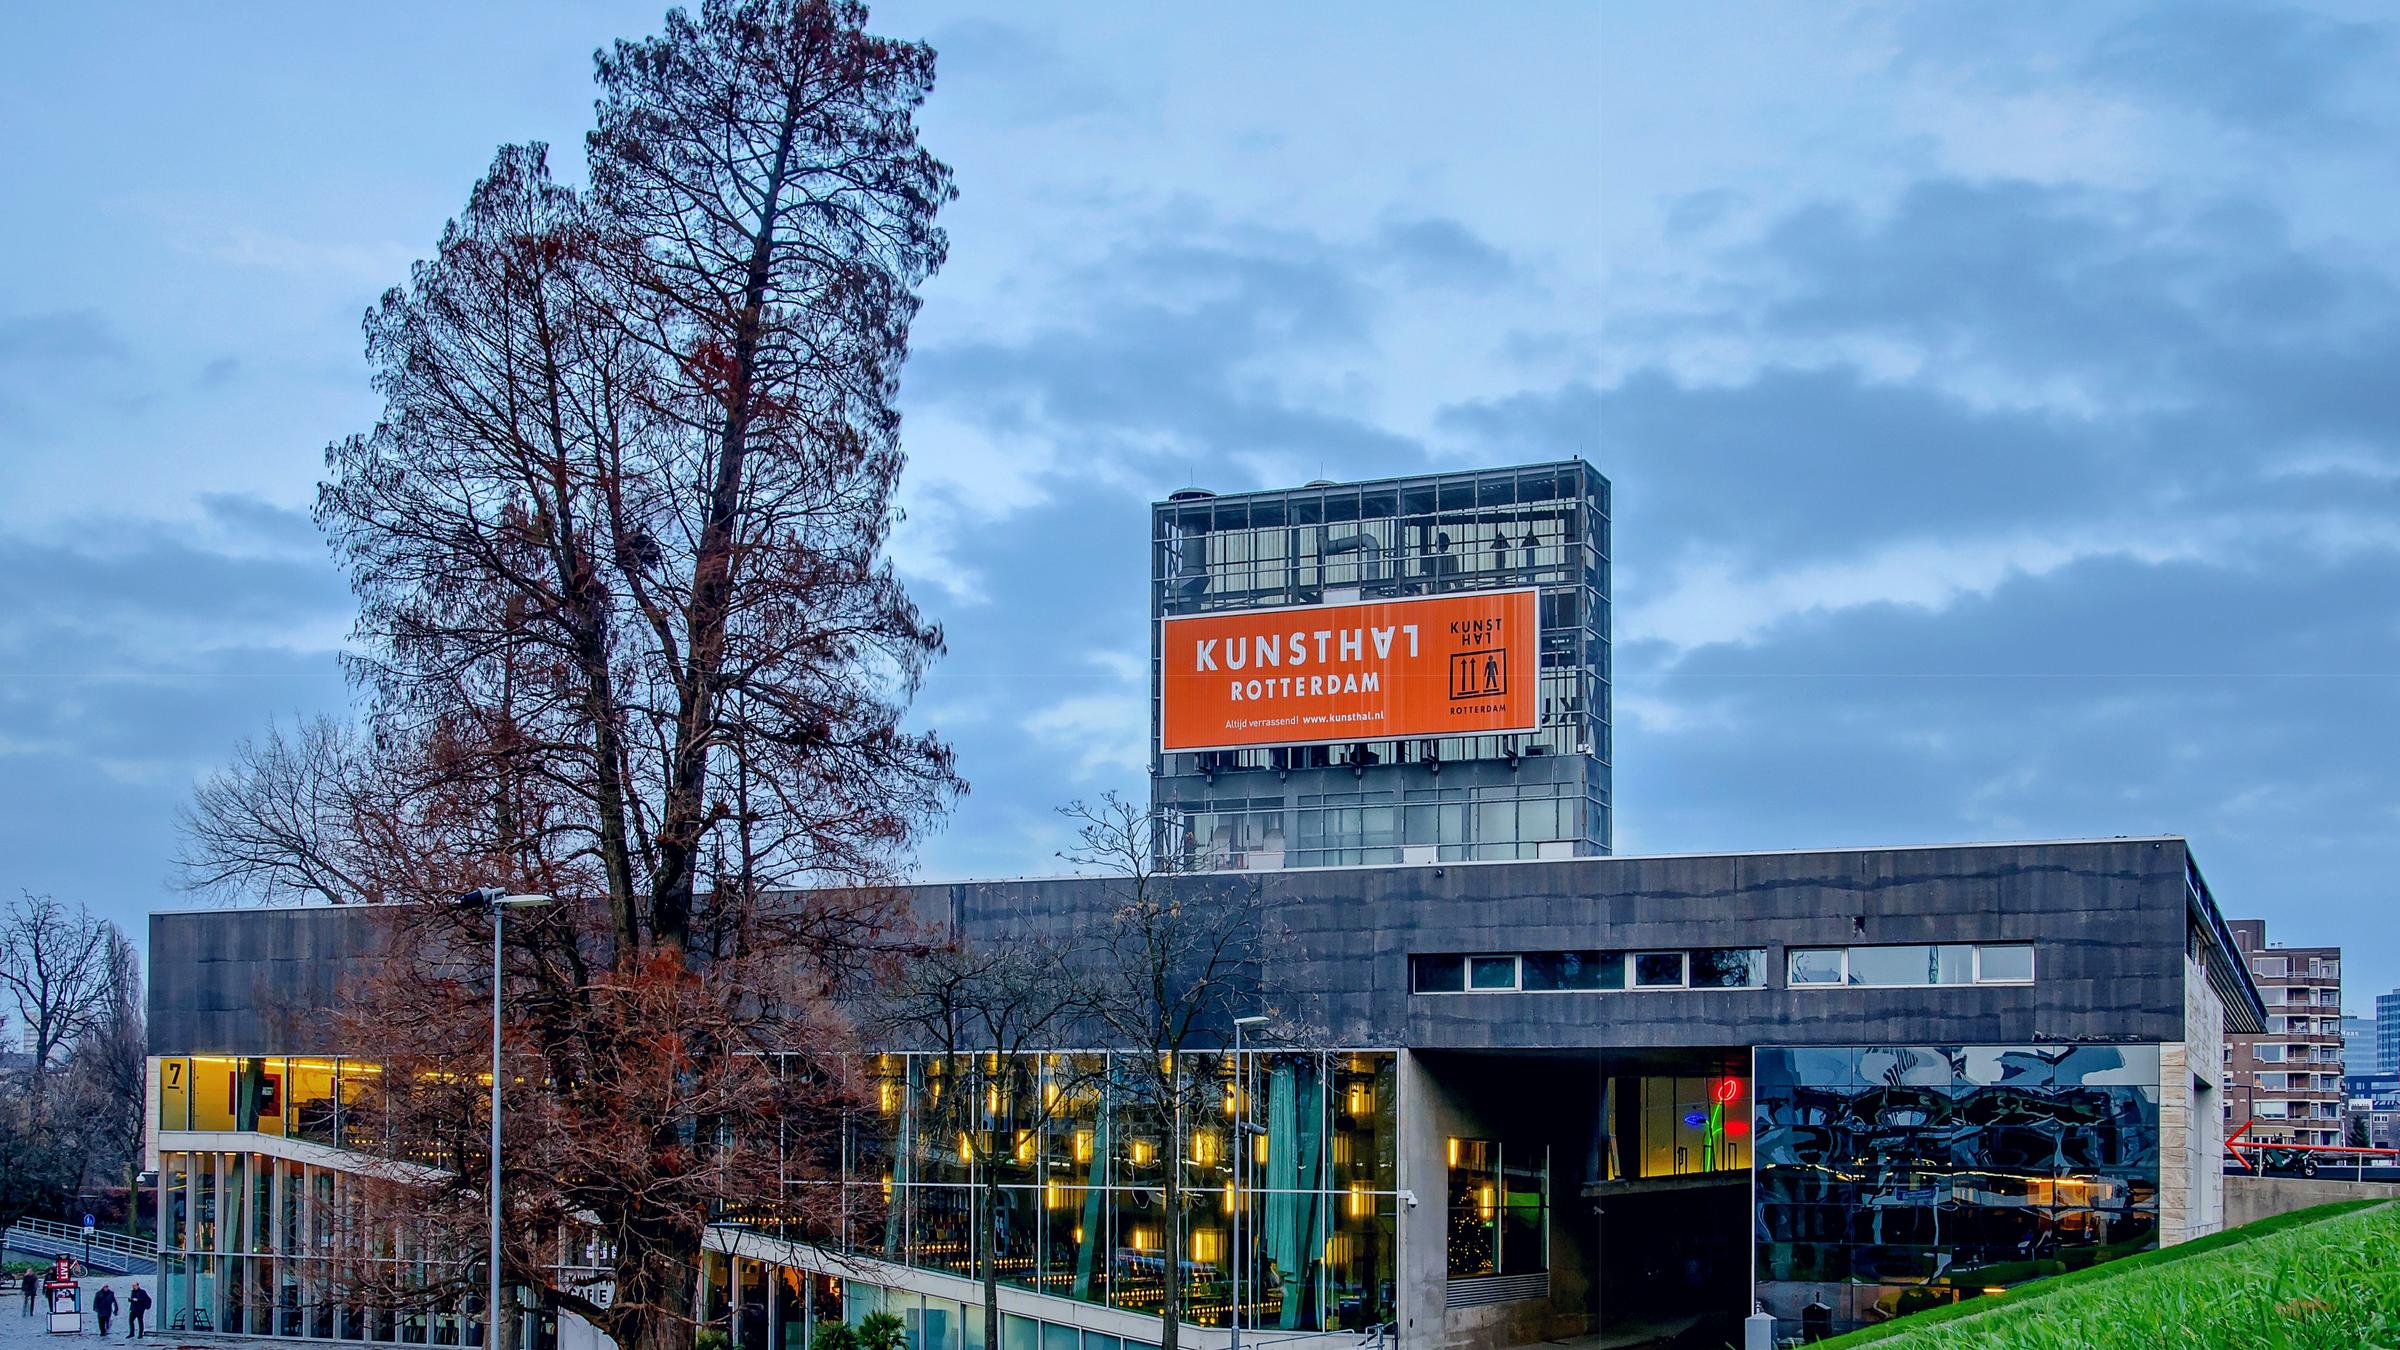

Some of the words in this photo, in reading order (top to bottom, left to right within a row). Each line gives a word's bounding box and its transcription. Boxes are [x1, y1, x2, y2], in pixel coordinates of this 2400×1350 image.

[1450, 619, 1502, 634] KUNST
[1196, 624, 1419, 672] KUNSTHAL
[1462, 632, 1491, 646] HAL
[1231, 671, 1380, 701] ROTTERDAM
[1450, 704, 1506, 715] ROTTERDAM
[1225, 719, 1247, 730] Altijd
[1249, 716, 1299, 727] verrassend!
[1303, 710, 1385, 724] www.kunsthal.nl
[169, 1063, 182, 1085] 7
[60, 1262, 69, 1279] LIVE
